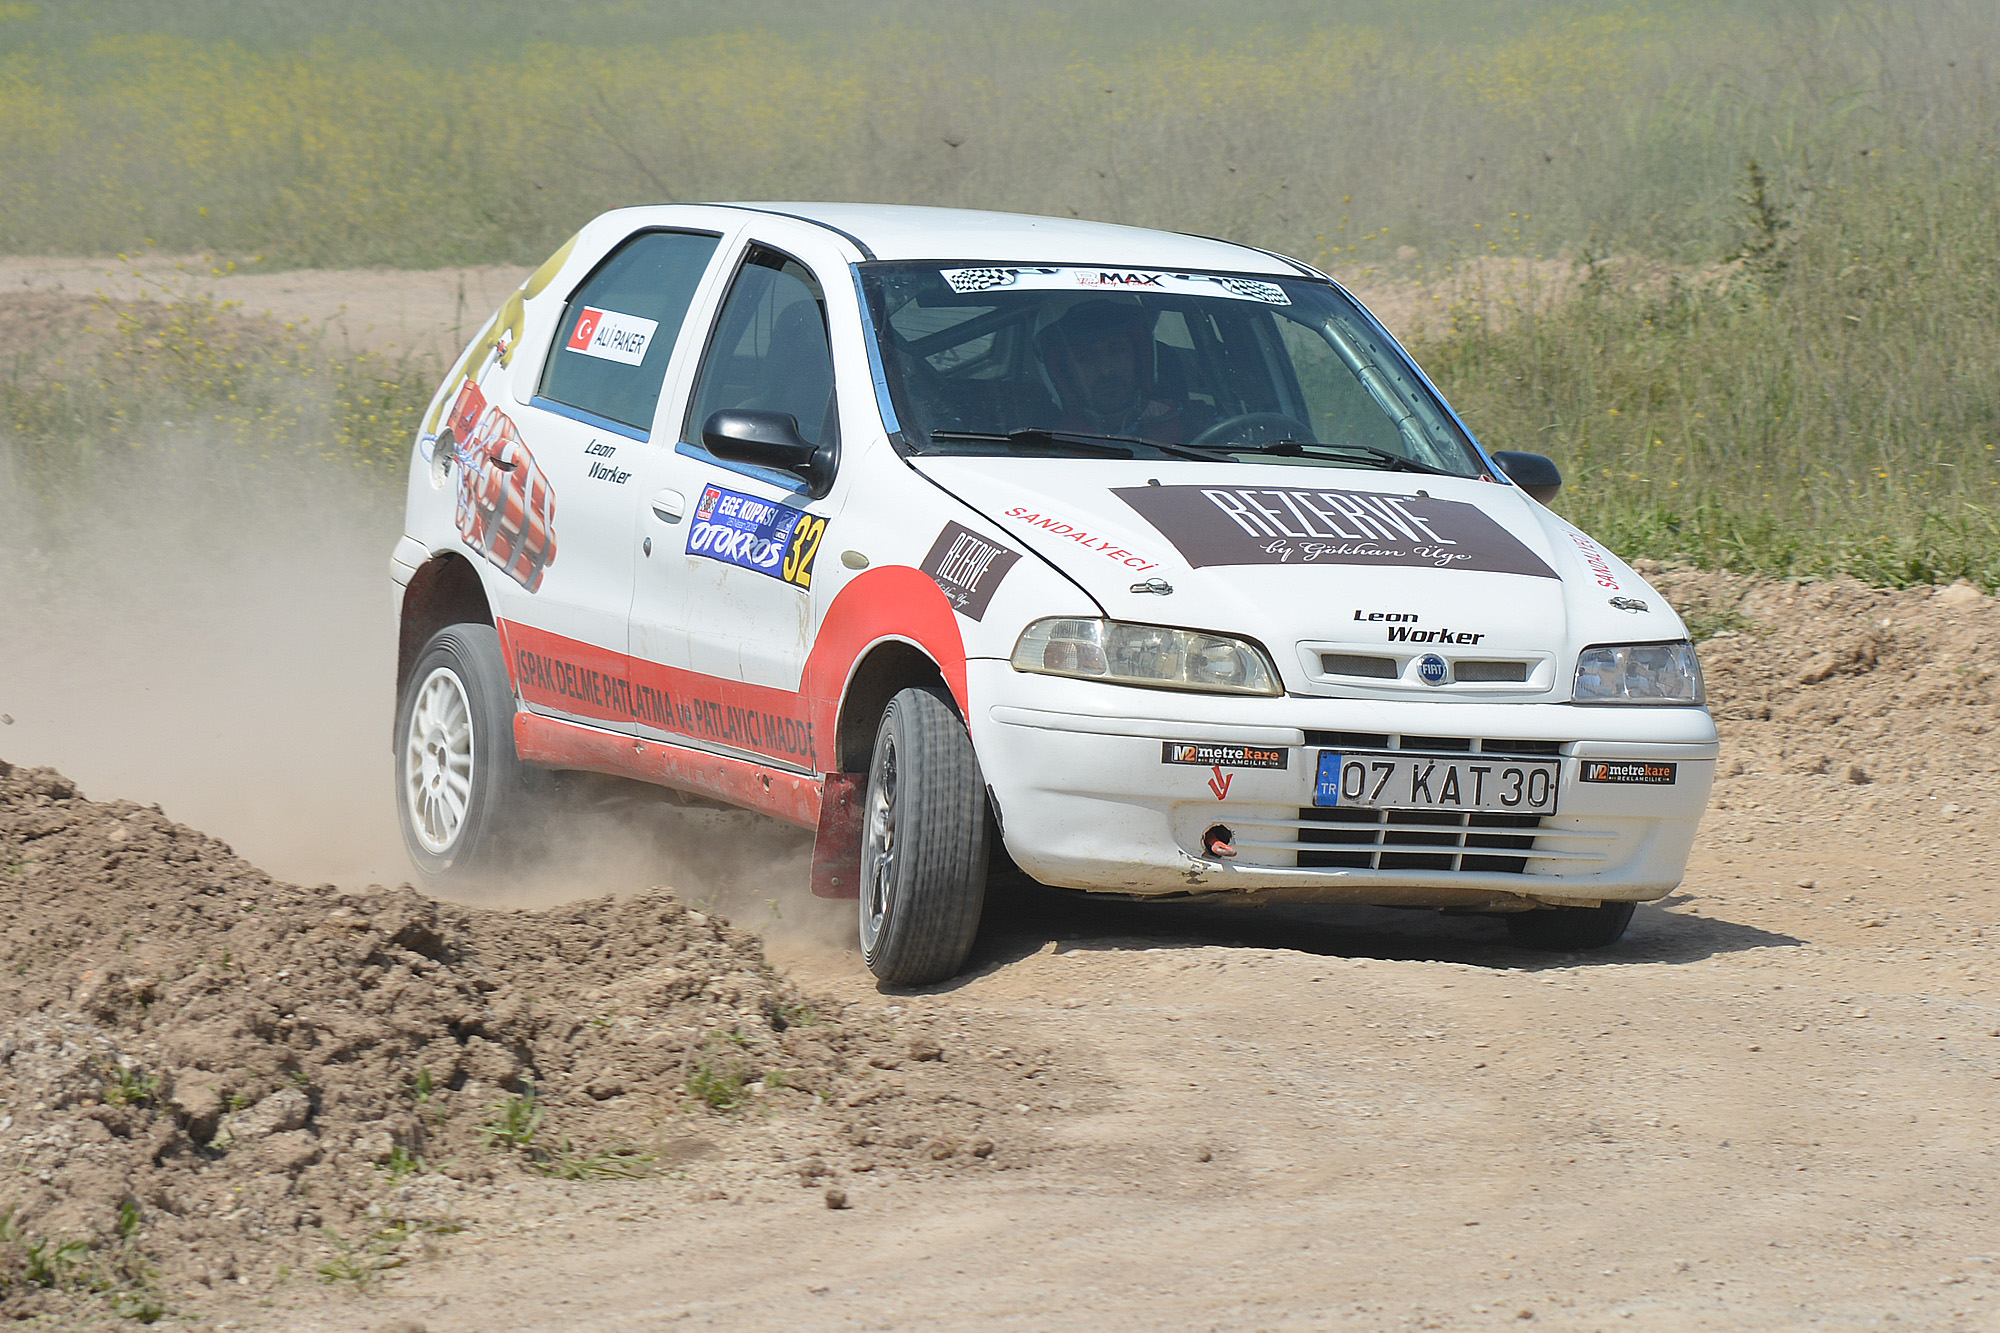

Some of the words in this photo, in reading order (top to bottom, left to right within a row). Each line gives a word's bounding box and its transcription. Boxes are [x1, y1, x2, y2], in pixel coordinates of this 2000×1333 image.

[611, 329, 647, 354] PAKER
[584, 438, 617, 458] Leon
[588, 461, 632, 484] Worker
[718, 495, 743, 518] EGE
[737, 499, 779, 527] KUPASI
[1200, 489, 1457, 545] REZERVE
[690, 521, 784, 568] OTOKROS
[782, 514, 826, 587] 32
[1260, 539, 1294, 563] by
[1299, 542, 1406, 561] Gökhan
[935, 531, 1003, 593] REZERVE
[1353, 609, 1419, 623] Leon
[1387, 626, 1486, 645] Worker
[1422, 663, 1443, 675] FIAT
[555, 660, 603, 707] DELME
[602, 673, 677, 727] PATLATMA
[675, 702, 694, 732] ve
[693, 698, 763, 747] PATLAYICI
[1172, 745, 1197, 762] M2
[1198, 746, 1280, 760] metrekare
[1609, 763, 1671, 777] metrekare
[1321, 782, 1337, 795] TR
[1342, 761, 1396, 802] 07
[1410, 764, 1492, 806] KAT
[1499, 768, 1550, 809] 30
